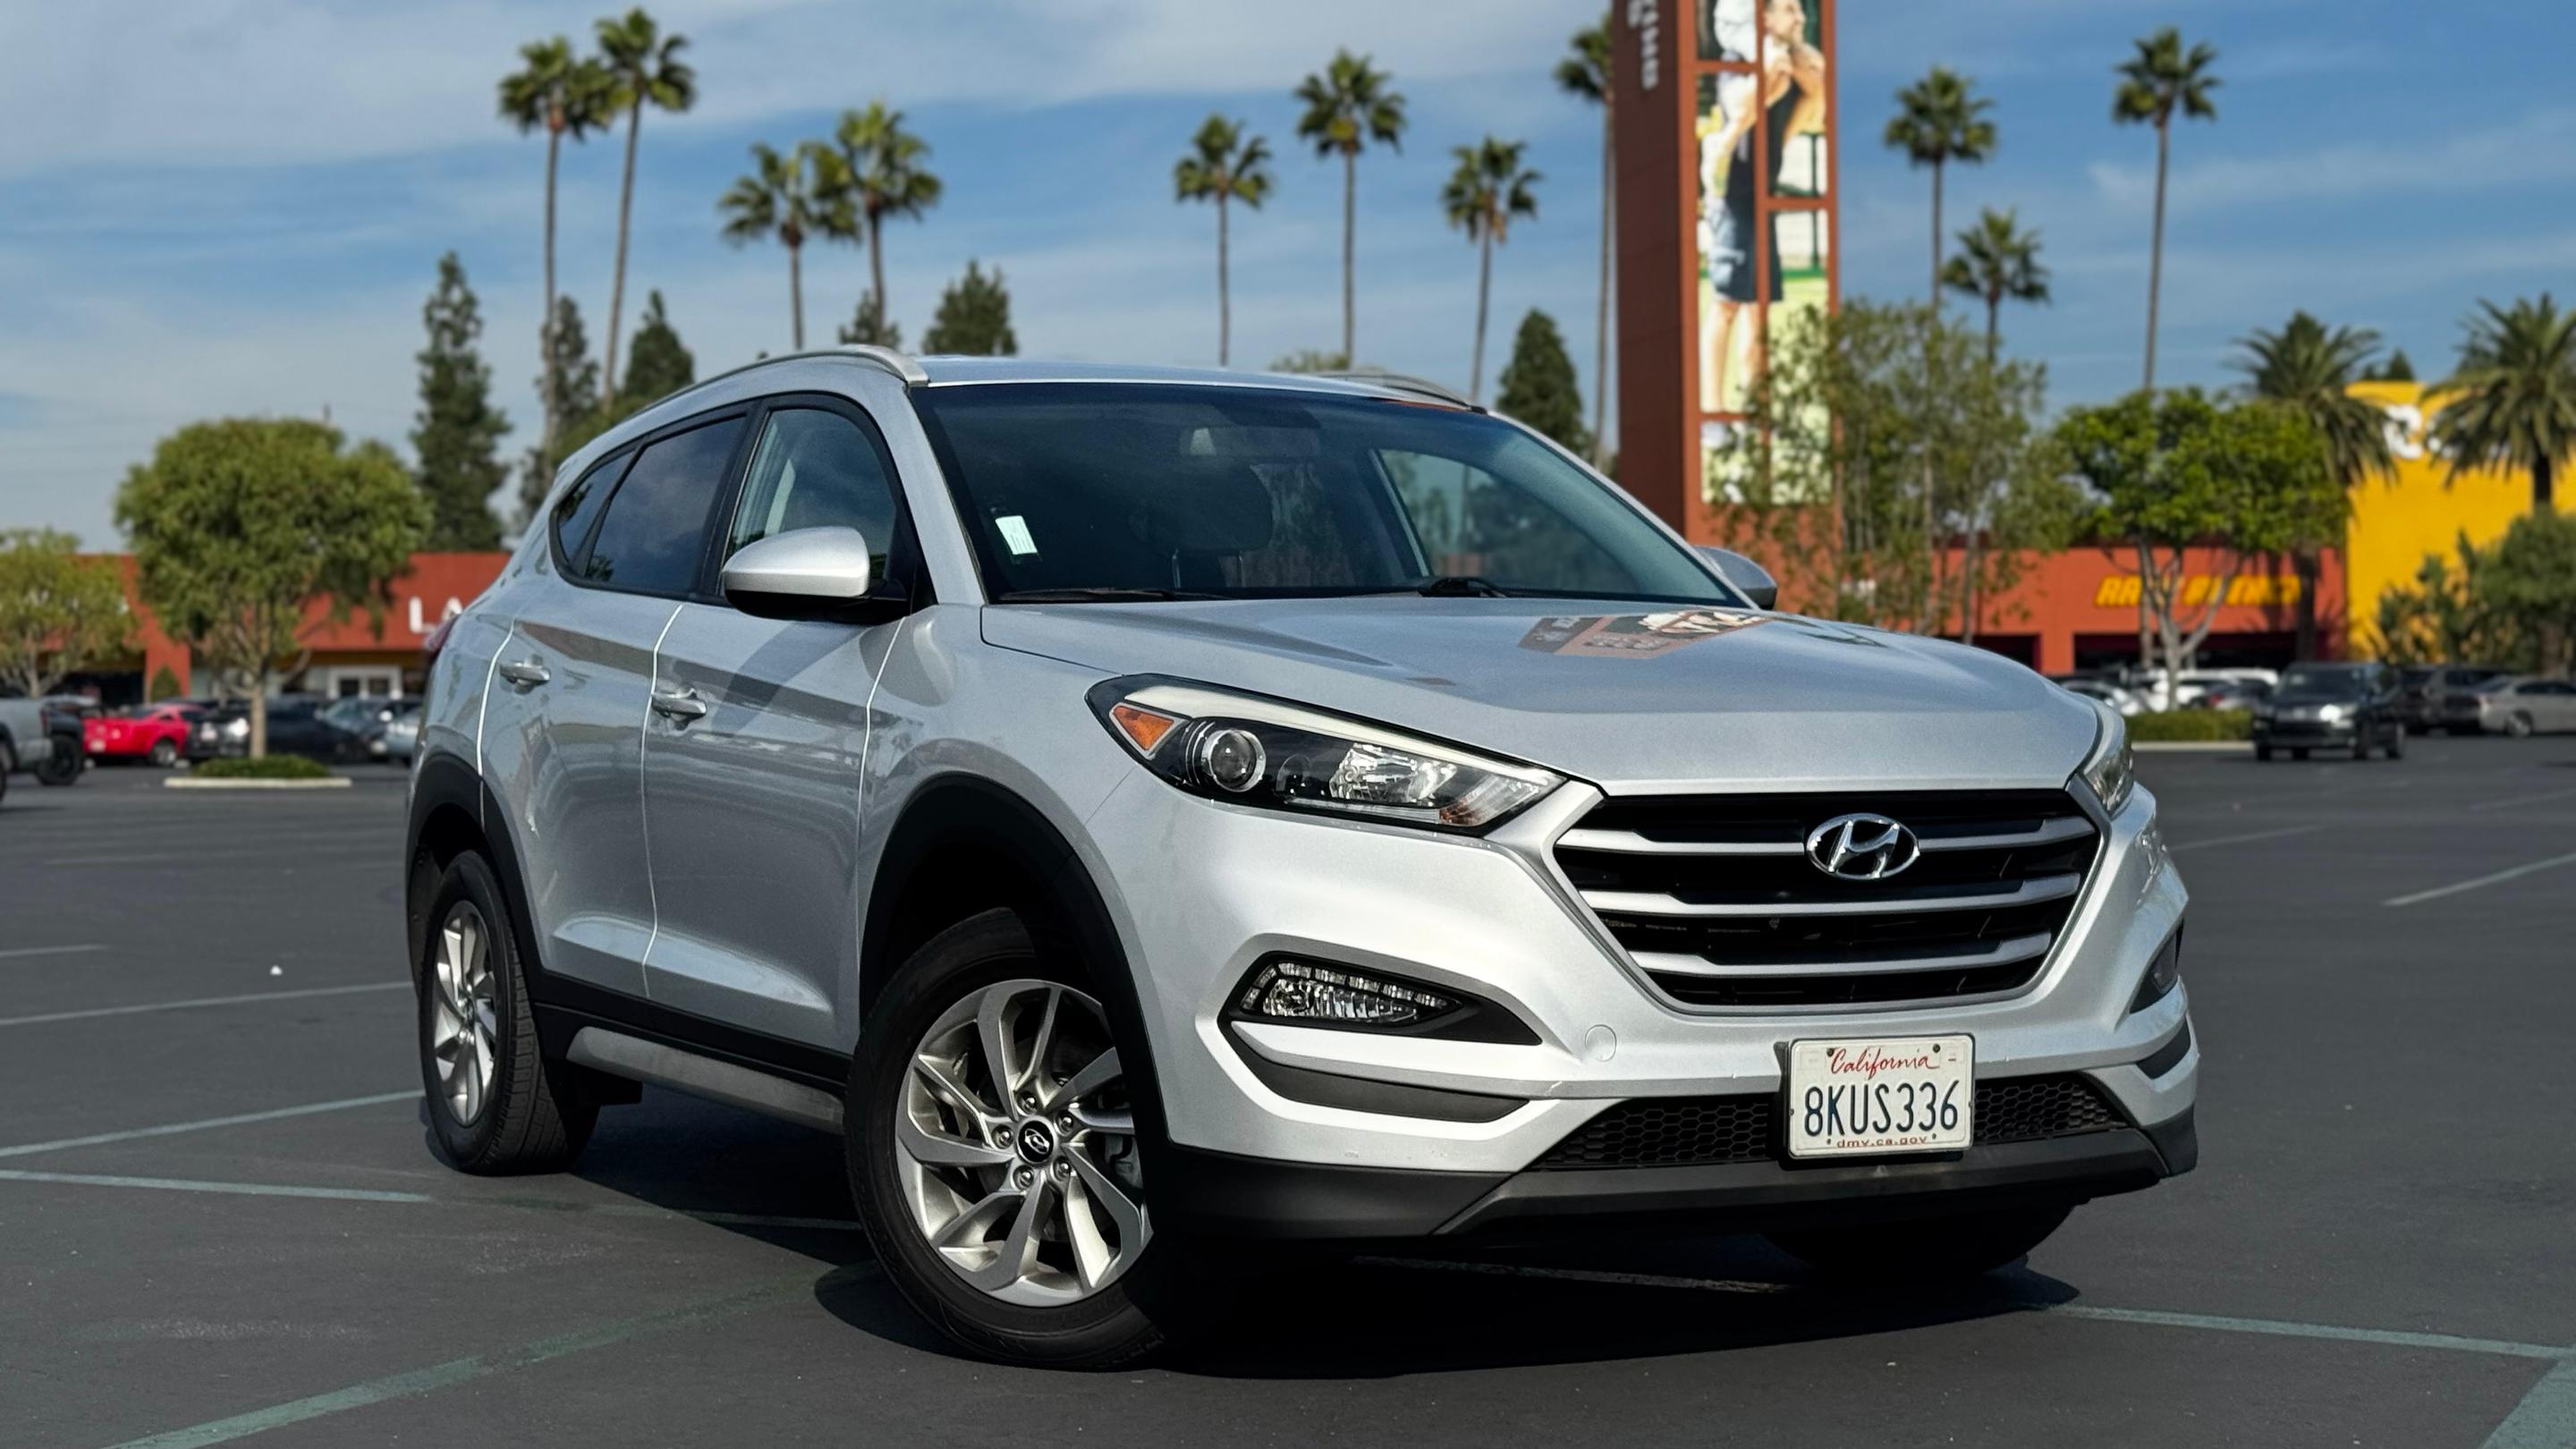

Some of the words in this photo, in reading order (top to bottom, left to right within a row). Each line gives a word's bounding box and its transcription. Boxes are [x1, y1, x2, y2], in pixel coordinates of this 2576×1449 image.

[1830, 1047, 1940, 1080] California
[1804, 1080, 1960, 1137] 8KUS336
[1836, 1136, 1928, 1148] dmv.ca.gov
